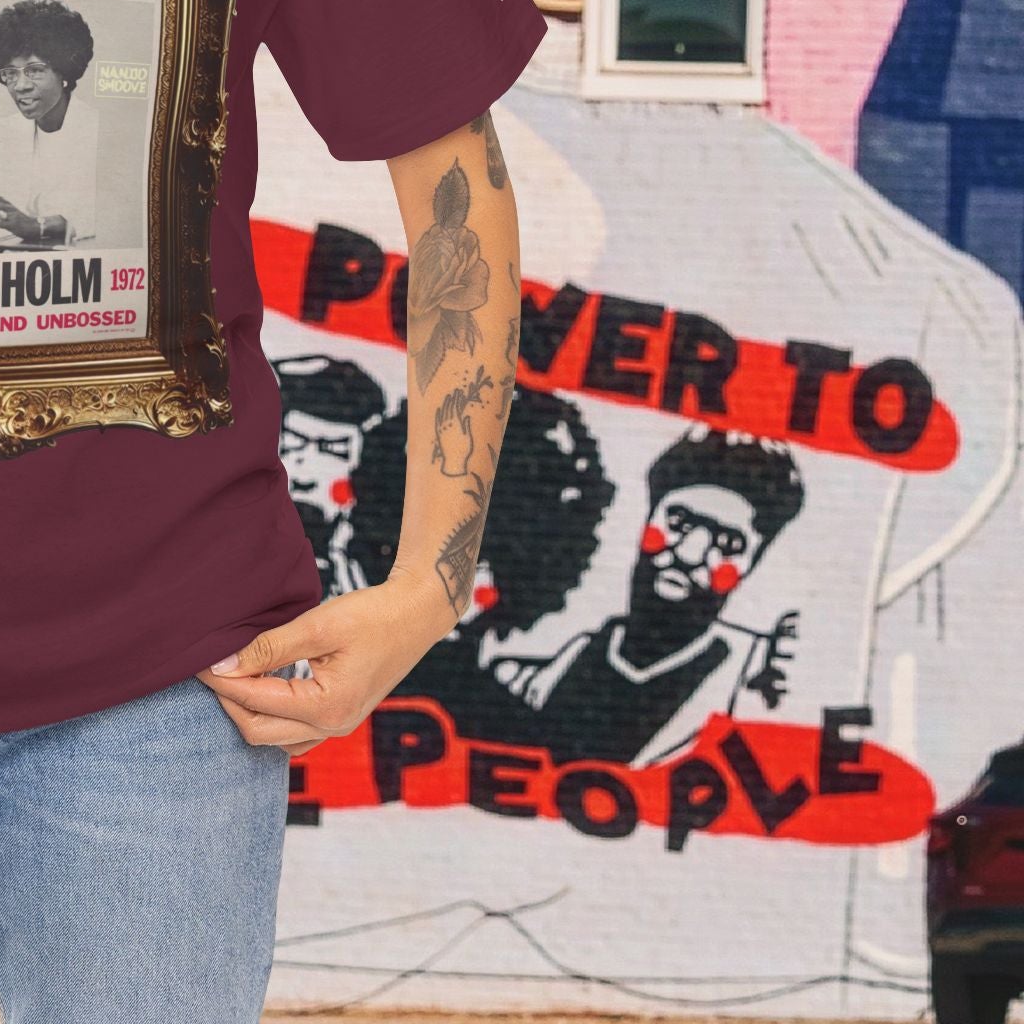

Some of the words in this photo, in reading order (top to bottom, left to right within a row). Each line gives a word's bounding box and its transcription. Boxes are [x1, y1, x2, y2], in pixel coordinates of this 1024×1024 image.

[36, 309, 137, 329] UNBOSSED
[110, 268, 145, 291] 1972
[299, 222, 738, 416] PWER
[785, 339, 934, 454] TO
[368, 706, 881, 852] PEOPLE
